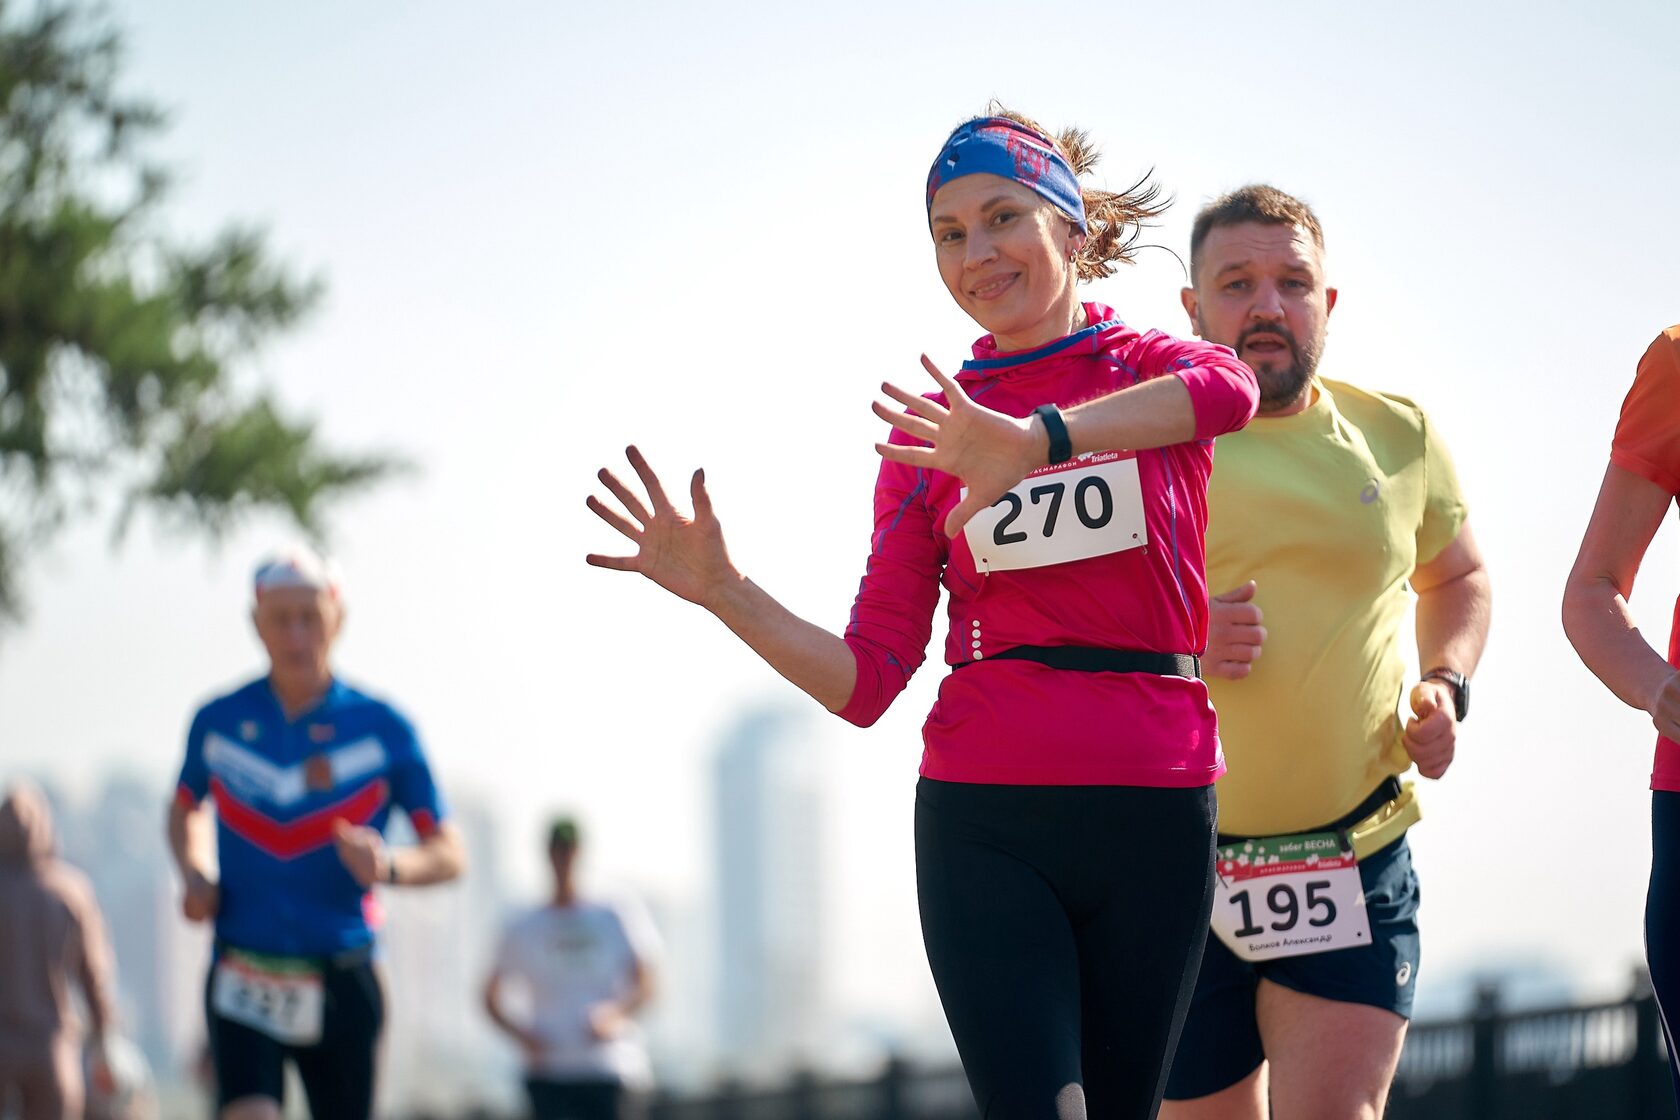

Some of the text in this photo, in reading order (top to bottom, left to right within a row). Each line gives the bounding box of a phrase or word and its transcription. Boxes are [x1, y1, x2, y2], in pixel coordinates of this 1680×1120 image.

[990, 476, 1113, 545] 270
[1304, 839, 1336, 850] ВЕСНА
[1228, 880, 1337, 938] 195
